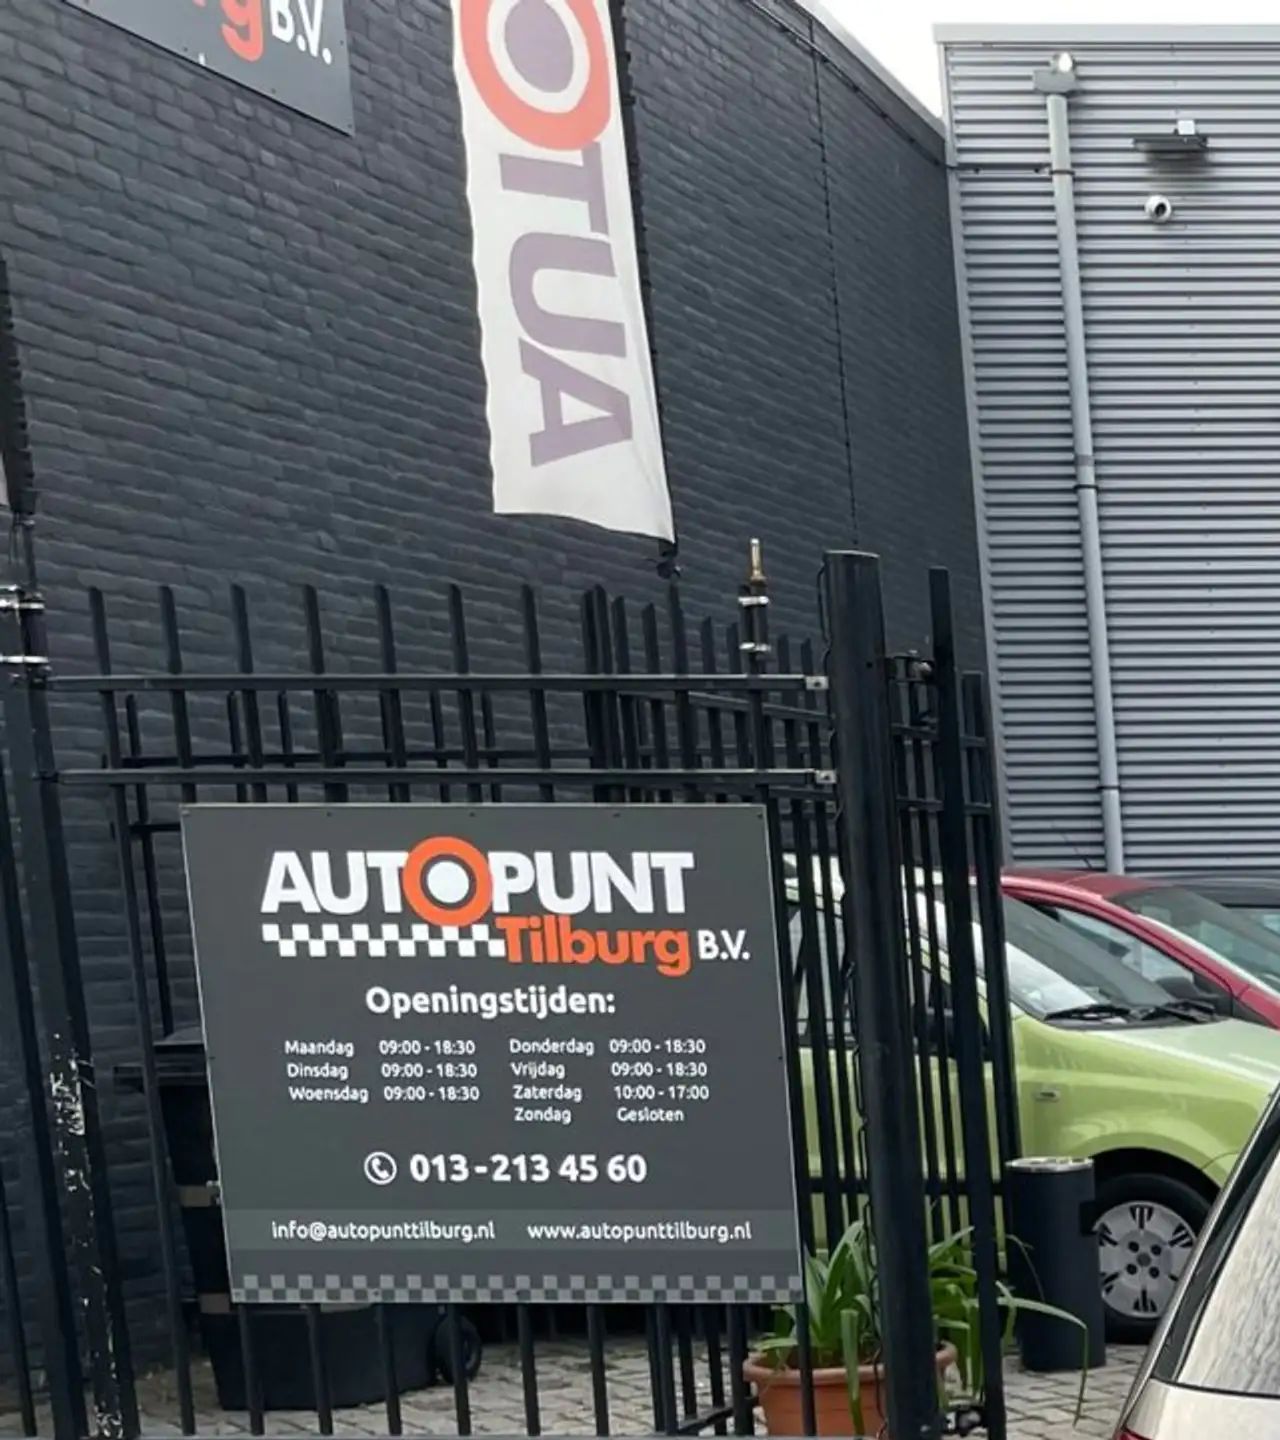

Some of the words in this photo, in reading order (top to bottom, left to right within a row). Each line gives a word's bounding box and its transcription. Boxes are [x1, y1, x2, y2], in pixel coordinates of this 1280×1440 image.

[261, 836, 694, 927] AUTOPUNT
[496, 915, 691, 977] Tilburg
[698, 930, 750, 959] B.V.
[366, 985, 615, 1019] Openingstijden:
[285, 1040, 354, 1057] Maandag
[379, 1040, 421, 1054] 09:00
[434, 1040, 475, 1055] 18:30
[510, 1038, 594, 1056] Donderdag
[609, 1039, 651, 1053] 09:00
[665, 1039, 706, 1053] 18:30
[287, 1062, 348, 1080] Dinsdag
[381, 1063, 423, 1077] 09:00
[436, 1063, 477, 1077] 18:30
[510, 1061, 565, 1079] Vrijdag
[611, 1062, 653, 1077] 09:00
[666, 1062, 707, 1077] 18:30
[289, 1085, 368, 1103] Woensdag
[384, 1086, 426, 1100] 09:00
[438, 1086, 479, 1100] 18:30
[513, 1084, 582, 1102] Zaterdag
[614, 1085, 655, 1099] 10:00
[668, 1084, 709, 1099] 17:00
[514, 1107, 571, 1124] Zondag
[617, 1107, 684, 1121] Gesloten
[558, 1155, 598, 1181] 45
[607, 1155, 646, 1182] 60
[272, 1220, 495, 1243] info@autopunttilburg.nl
[528, 1221, 752, 1243] www.autopunttilburg.nl
